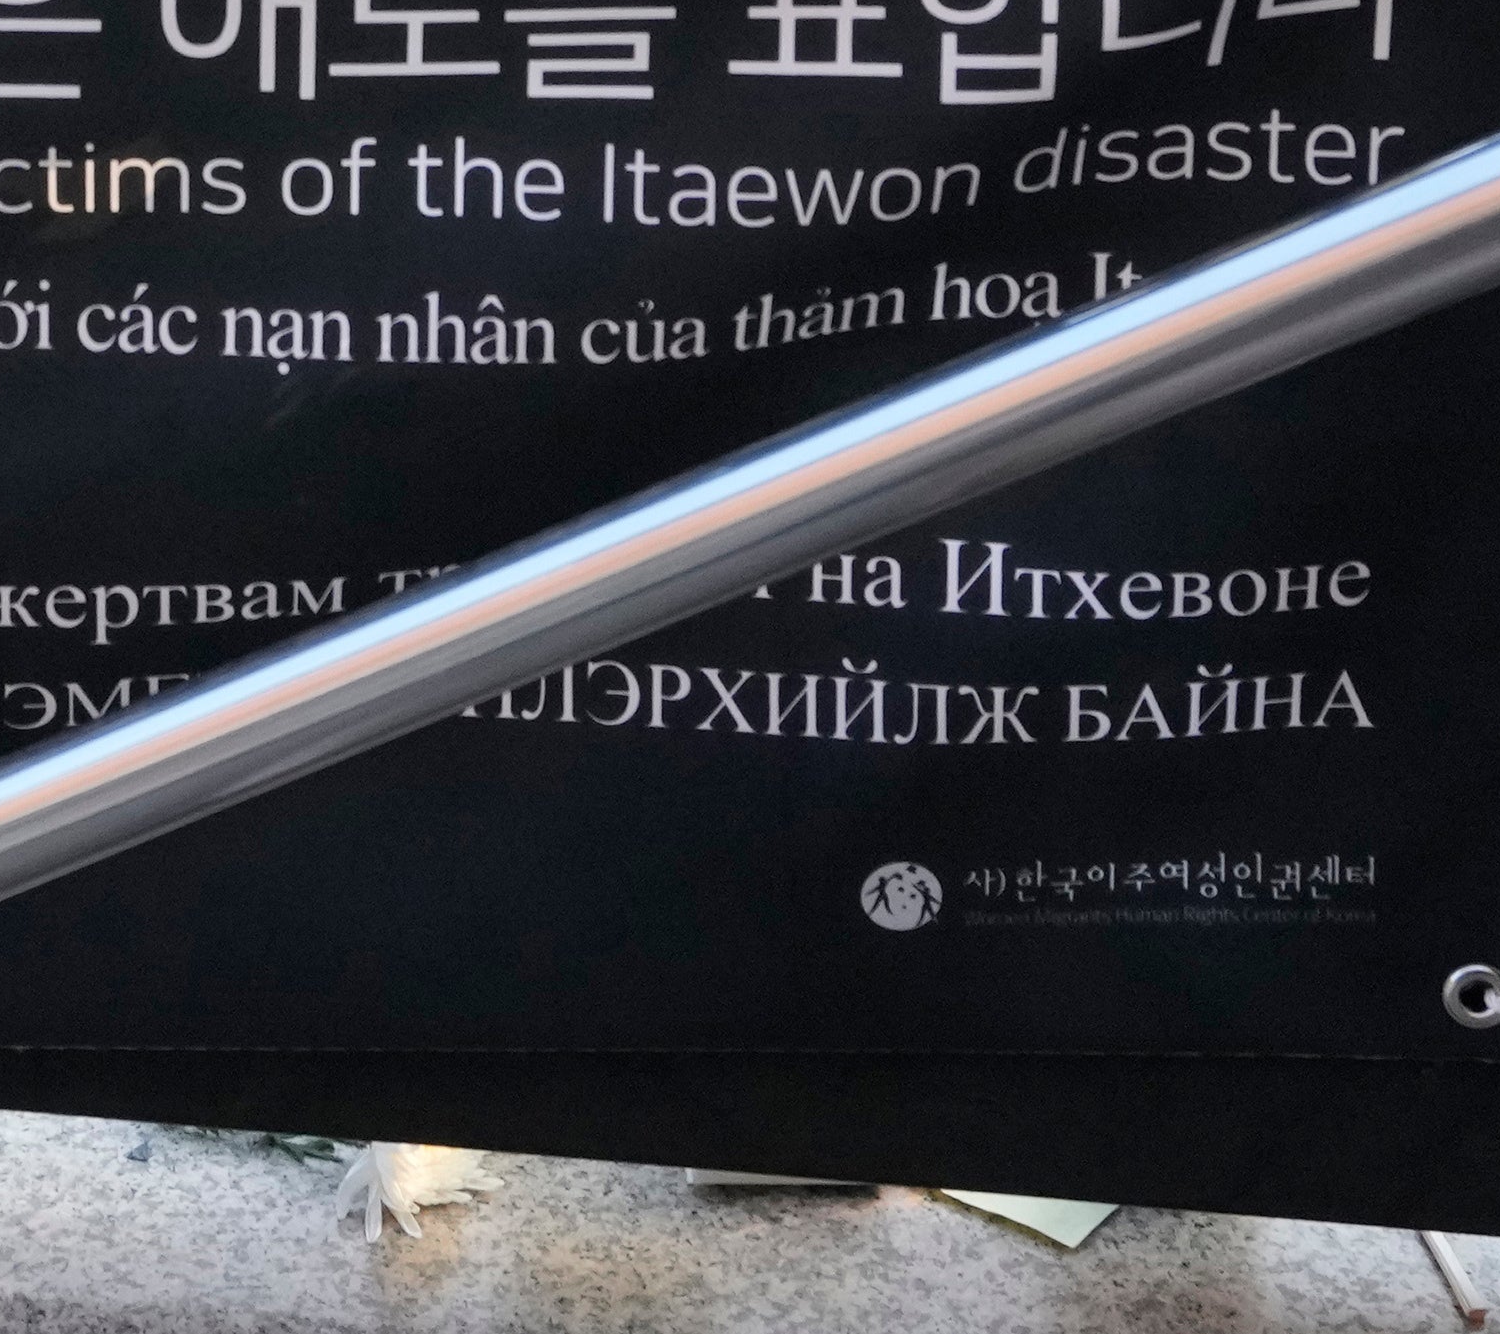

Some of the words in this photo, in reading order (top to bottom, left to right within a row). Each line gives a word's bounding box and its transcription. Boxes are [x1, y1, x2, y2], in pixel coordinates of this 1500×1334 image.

[280, 136, 380, 219] of
[407, 135, 567, 224] the
[602, 142, 983, 230] Itaewon
[1010, 103, 1408, 195] disaster
[76, 282, 200, 358] các
[220, 306, 356, 378] nạn
[376, 290, 558, 367] nhân
[580, 299, 709, 367] của
[735, 288, 907, 353] thảm
[812, 548, 910, 613] на
[940, 538, 1373, 622] Итхевоне
[462, 655, 1043, 748] ЛЭРХИЙЛЖ
[1066, 663, 1376, 744] БАЙНА
